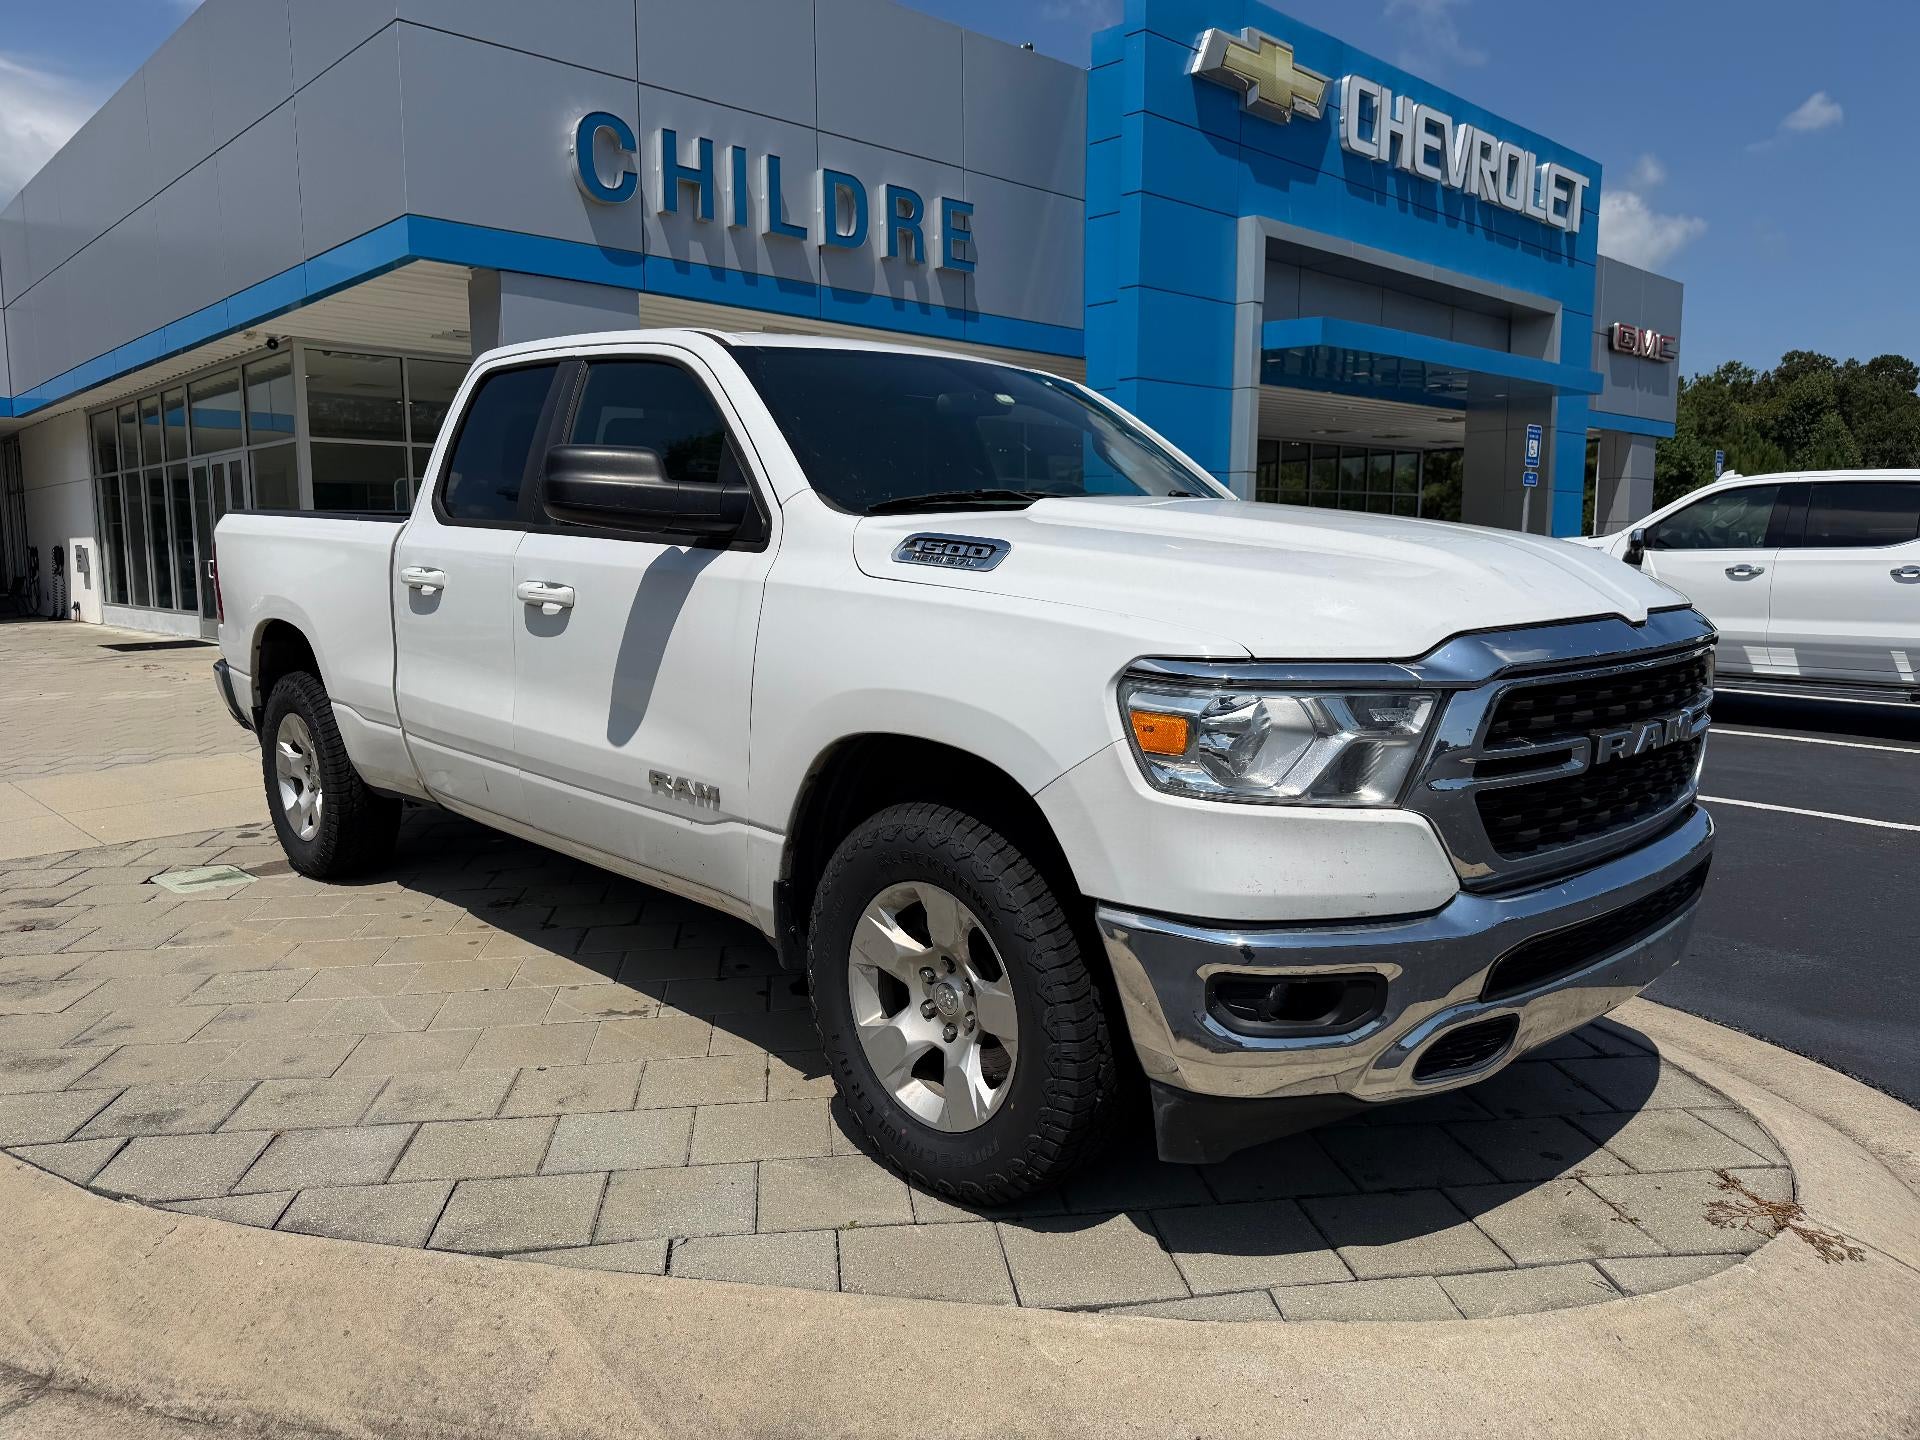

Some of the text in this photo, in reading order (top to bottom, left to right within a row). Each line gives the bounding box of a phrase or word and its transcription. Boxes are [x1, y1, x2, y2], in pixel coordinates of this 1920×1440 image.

[1340, 74, 1590, 234] CHEVROLET
[569, 111, 977, 273] CHILDRE
[1611, 322, 1677, 363] GMC
[905, 540, 992, 559] 1500
[1596, 711, 1693, 765] RAM
[648, 769, 721, 803] RAM
